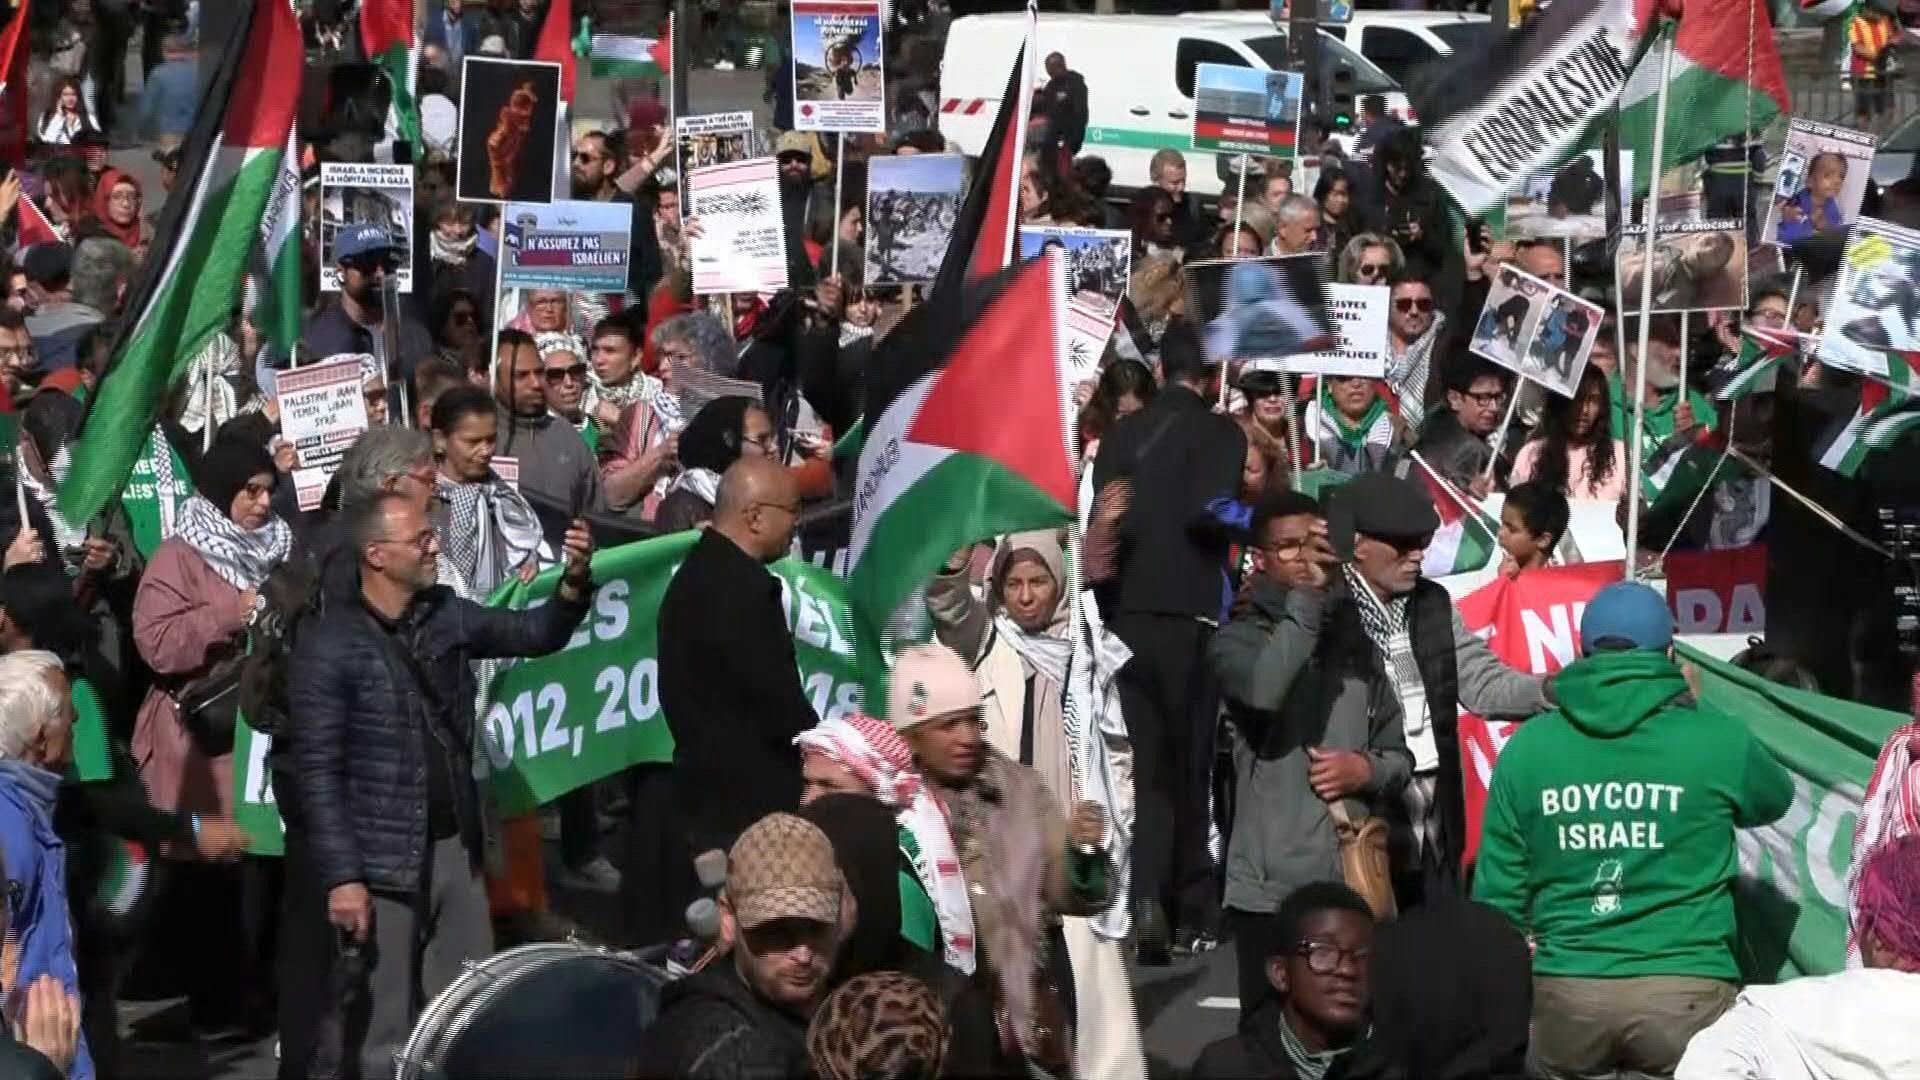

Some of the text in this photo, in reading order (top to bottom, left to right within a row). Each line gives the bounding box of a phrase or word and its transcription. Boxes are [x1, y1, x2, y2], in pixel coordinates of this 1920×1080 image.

[1462, 25, 1628, 182] EUROPALESTINE
[528, 236, 600, 251] N'ASSUREZ PAS
[284, 391, 328, 410] PALESTINE
[292, 405, 320, 420] YEMEN
[1541, 782, 1684, 816] BOYCOTT
[1558, 821, 1665, 850] ISRAEL
